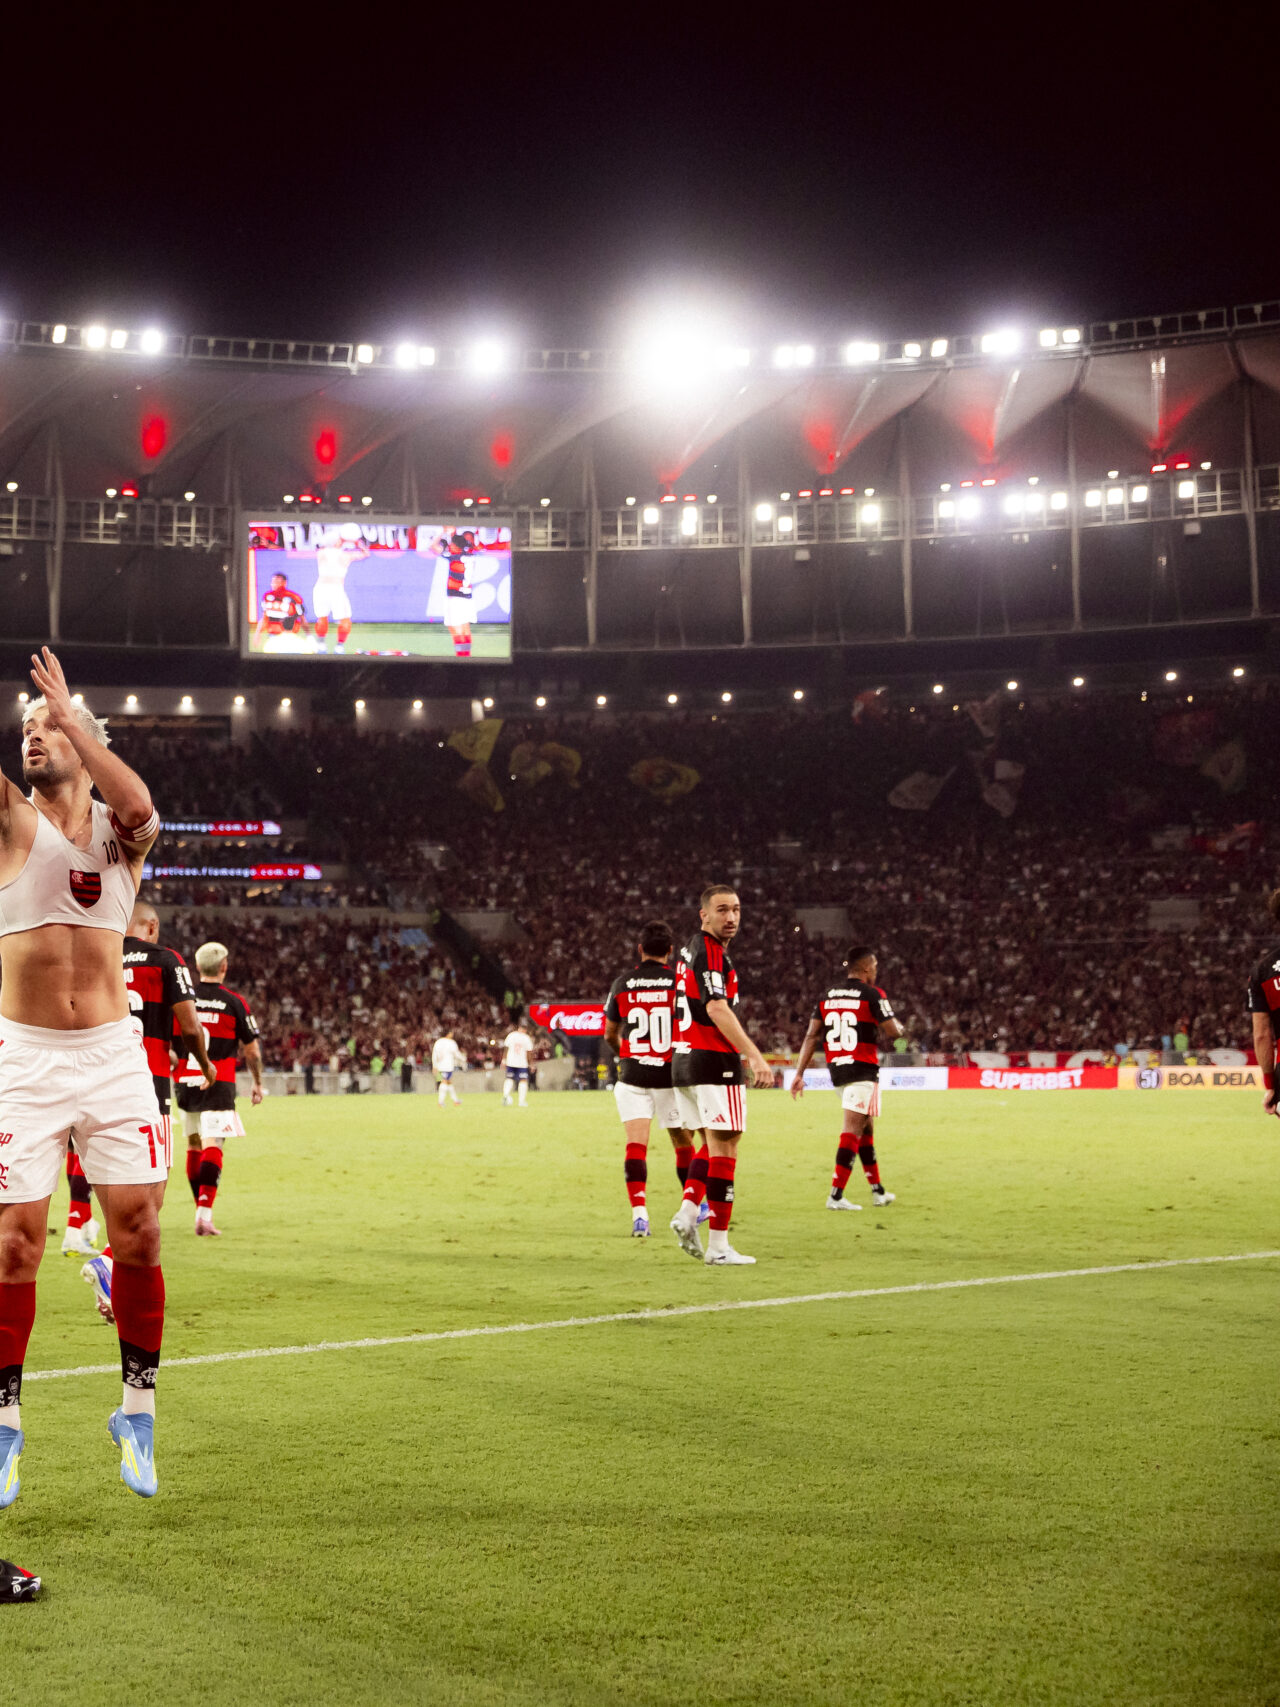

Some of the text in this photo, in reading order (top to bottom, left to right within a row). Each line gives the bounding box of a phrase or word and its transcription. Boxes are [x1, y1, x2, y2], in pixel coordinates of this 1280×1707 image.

[102, 840, 119, 864] 10
[627, 1007, 672, 1053] 20
[825, 1011, 858, 1052] 26
[980, 1069, 1084, 1090] SUPERBET
[1168, 1073, 1204, 1086] BOA
